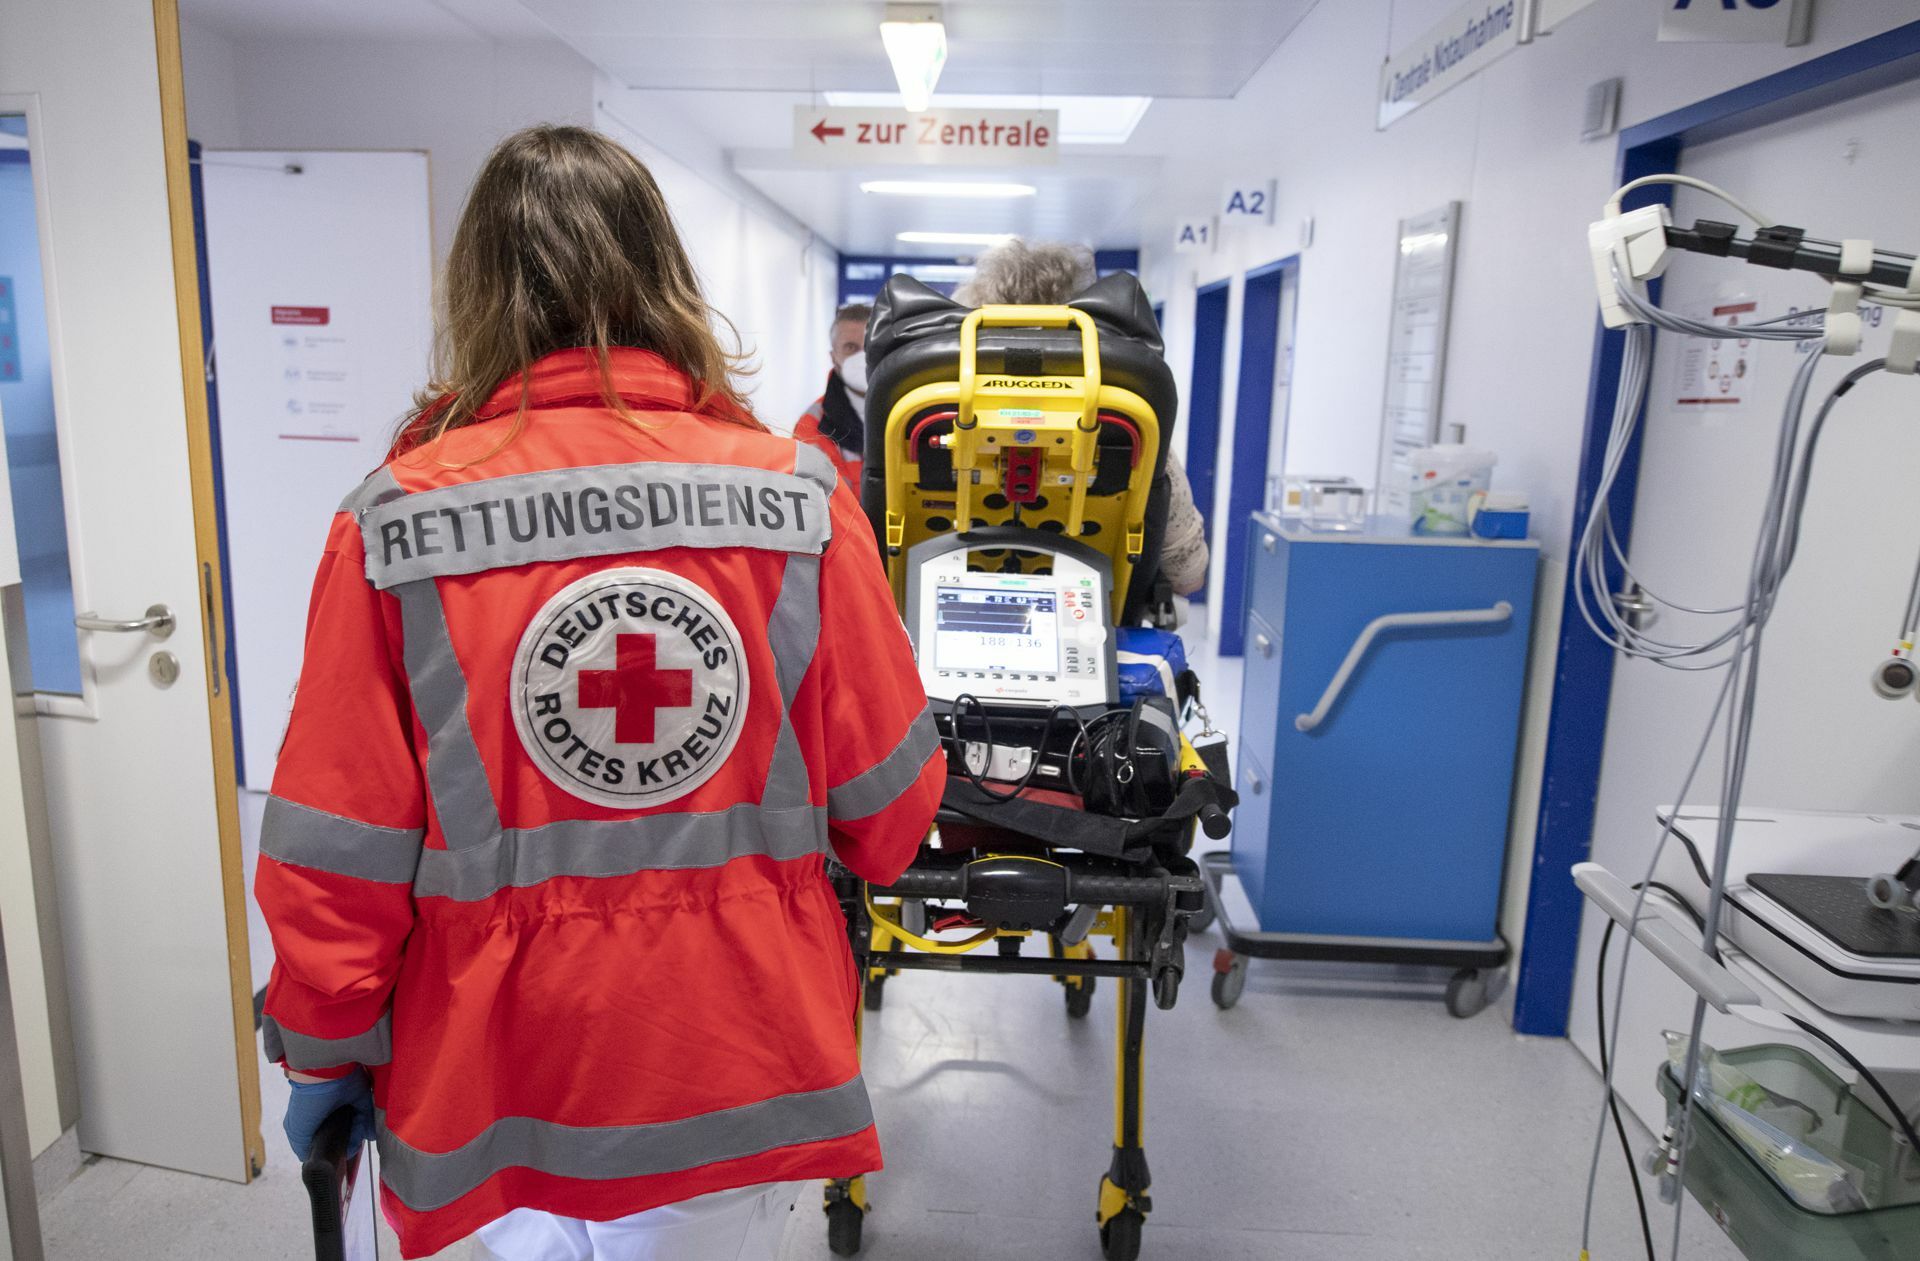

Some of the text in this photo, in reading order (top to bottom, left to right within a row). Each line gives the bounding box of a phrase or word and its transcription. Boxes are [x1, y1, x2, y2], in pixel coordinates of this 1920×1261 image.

[1392, 0, 1513, 104] Zentrale Notaufnahme
[856, 117, 1050, 147] zur Zentrale
[1226, 190, 1265, 215] A2
[1179, 225, 1208, 244] A1
[992, 379, 1063, 390] RUGGED
[380, 481, 809, 567] RETTUNGSDIENST
[540, 591, 729, 670] DEUTSCHES
[981, 636, 1042, 648] 188 136
[534, 692, 732, 786] ROTES KREUZ
